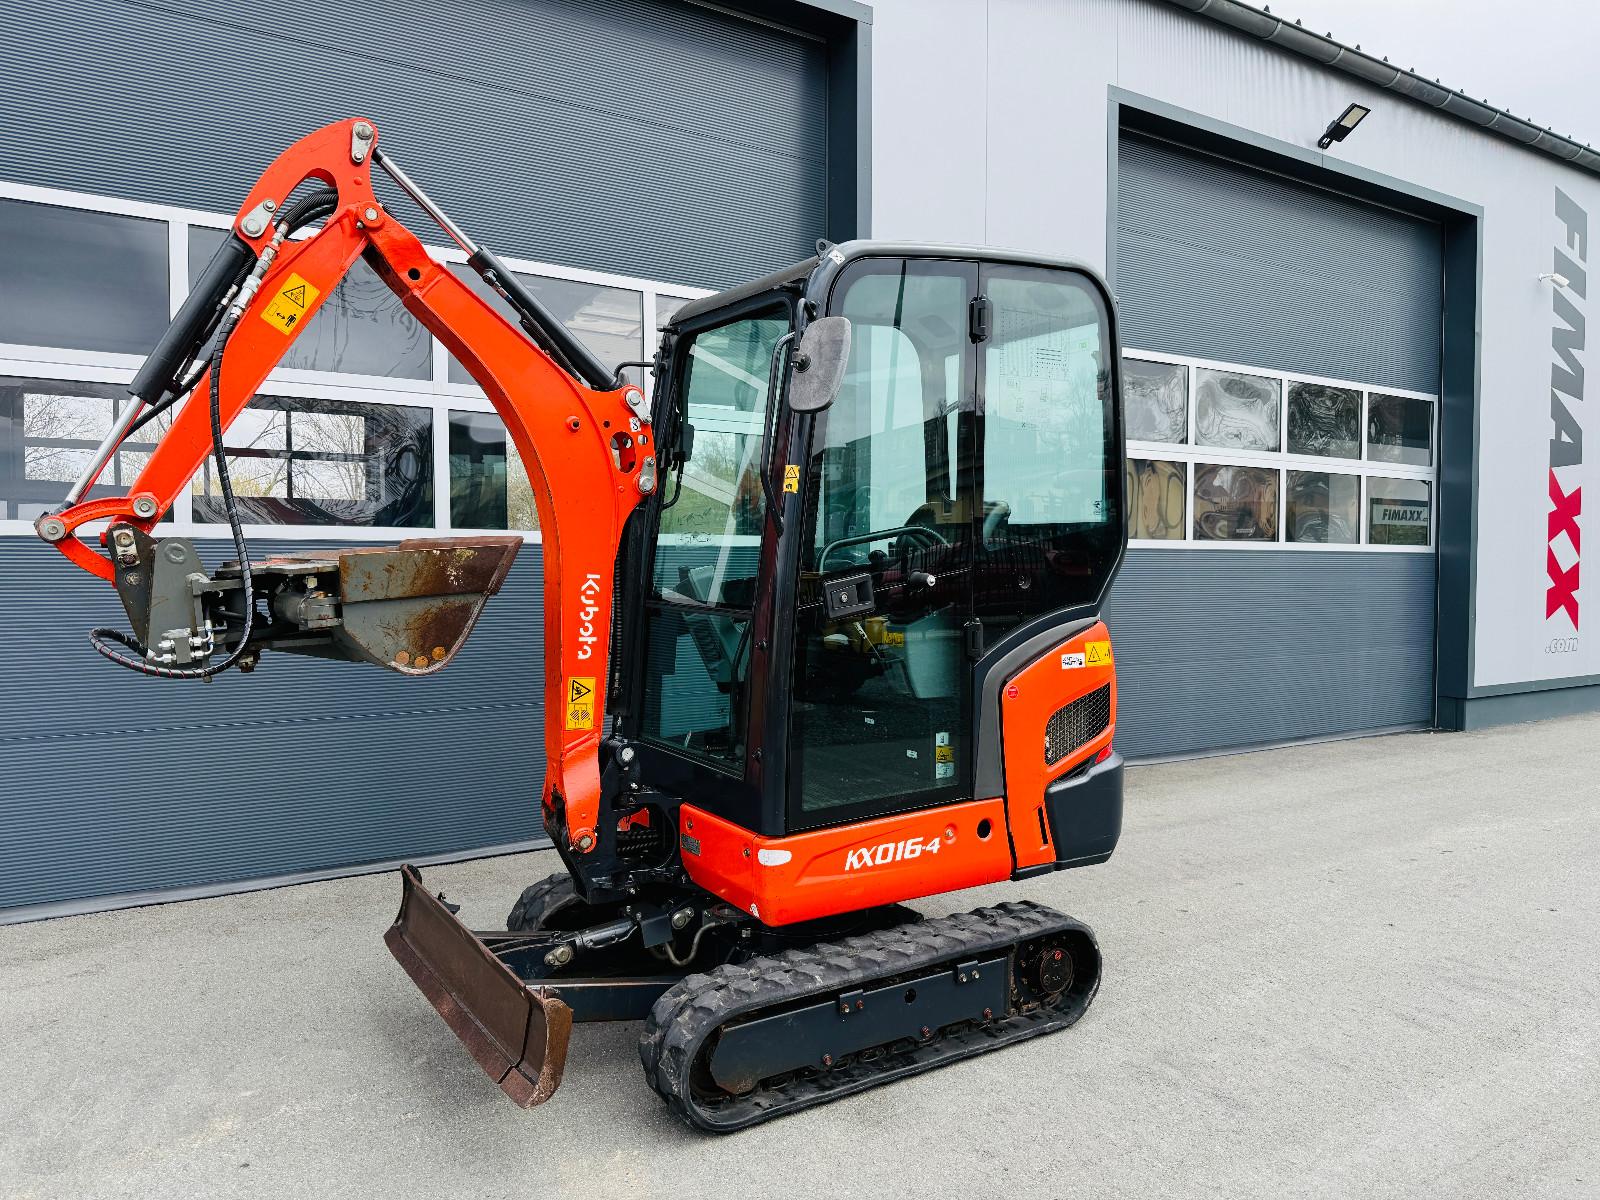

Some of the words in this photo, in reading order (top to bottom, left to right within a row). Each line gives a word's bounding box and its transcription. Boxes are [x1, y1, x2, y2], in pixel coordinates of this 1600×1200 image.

[1545, 185, 1588, 633] FIMAXX
[1382, 508, 1423, 521] FIMAXX
[577, 573, 601, 660] Kubota
[1544, 637, 1579, 655] .com
[844, 836, 941, 872] KX016-4
